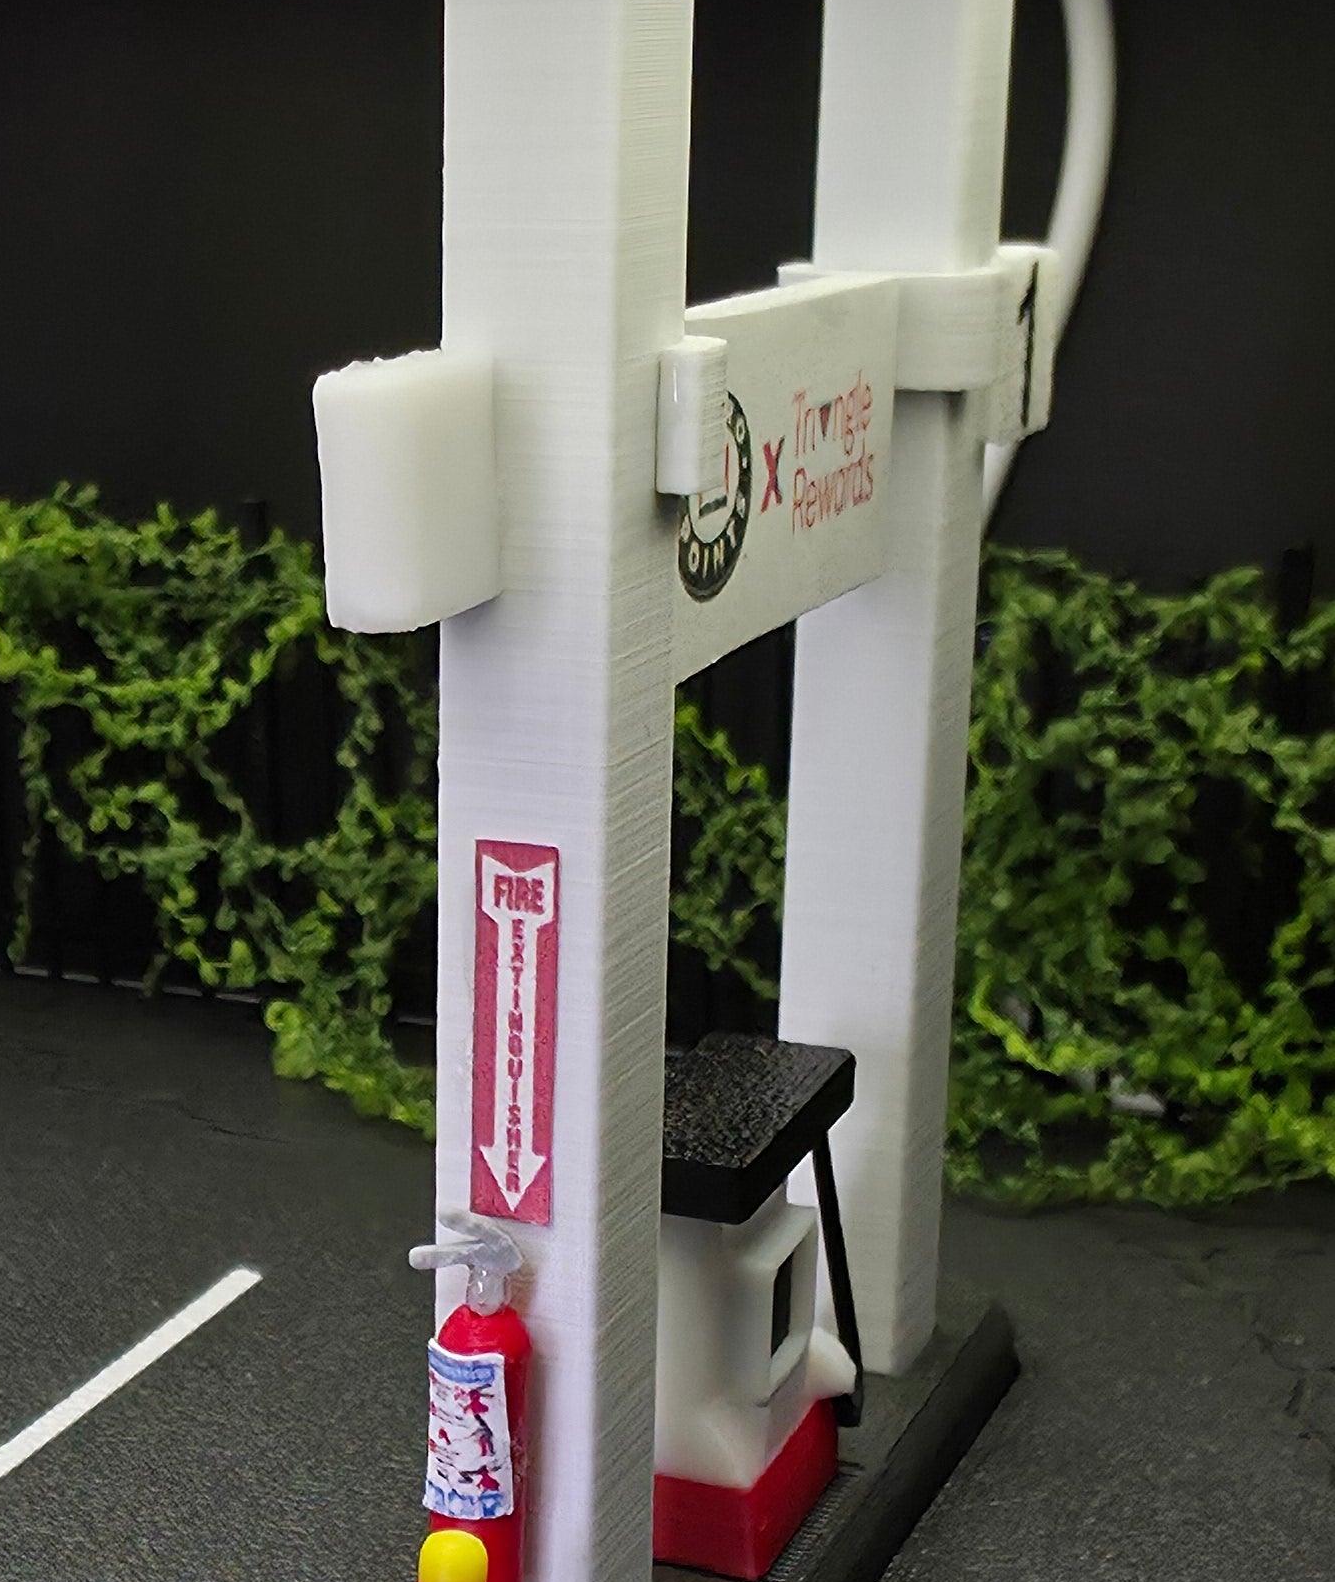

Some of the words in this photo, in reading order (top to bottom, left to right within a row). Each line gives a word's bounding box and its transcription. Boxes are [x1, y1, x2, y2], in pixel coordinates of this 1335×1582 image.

[1017, 260, 1040, 427] 1
[792, 439, 874, 538] Rewards
[493, 874, 545, 915] FIRE
[505, 919, 525, 1194] EXTINGUISHER
